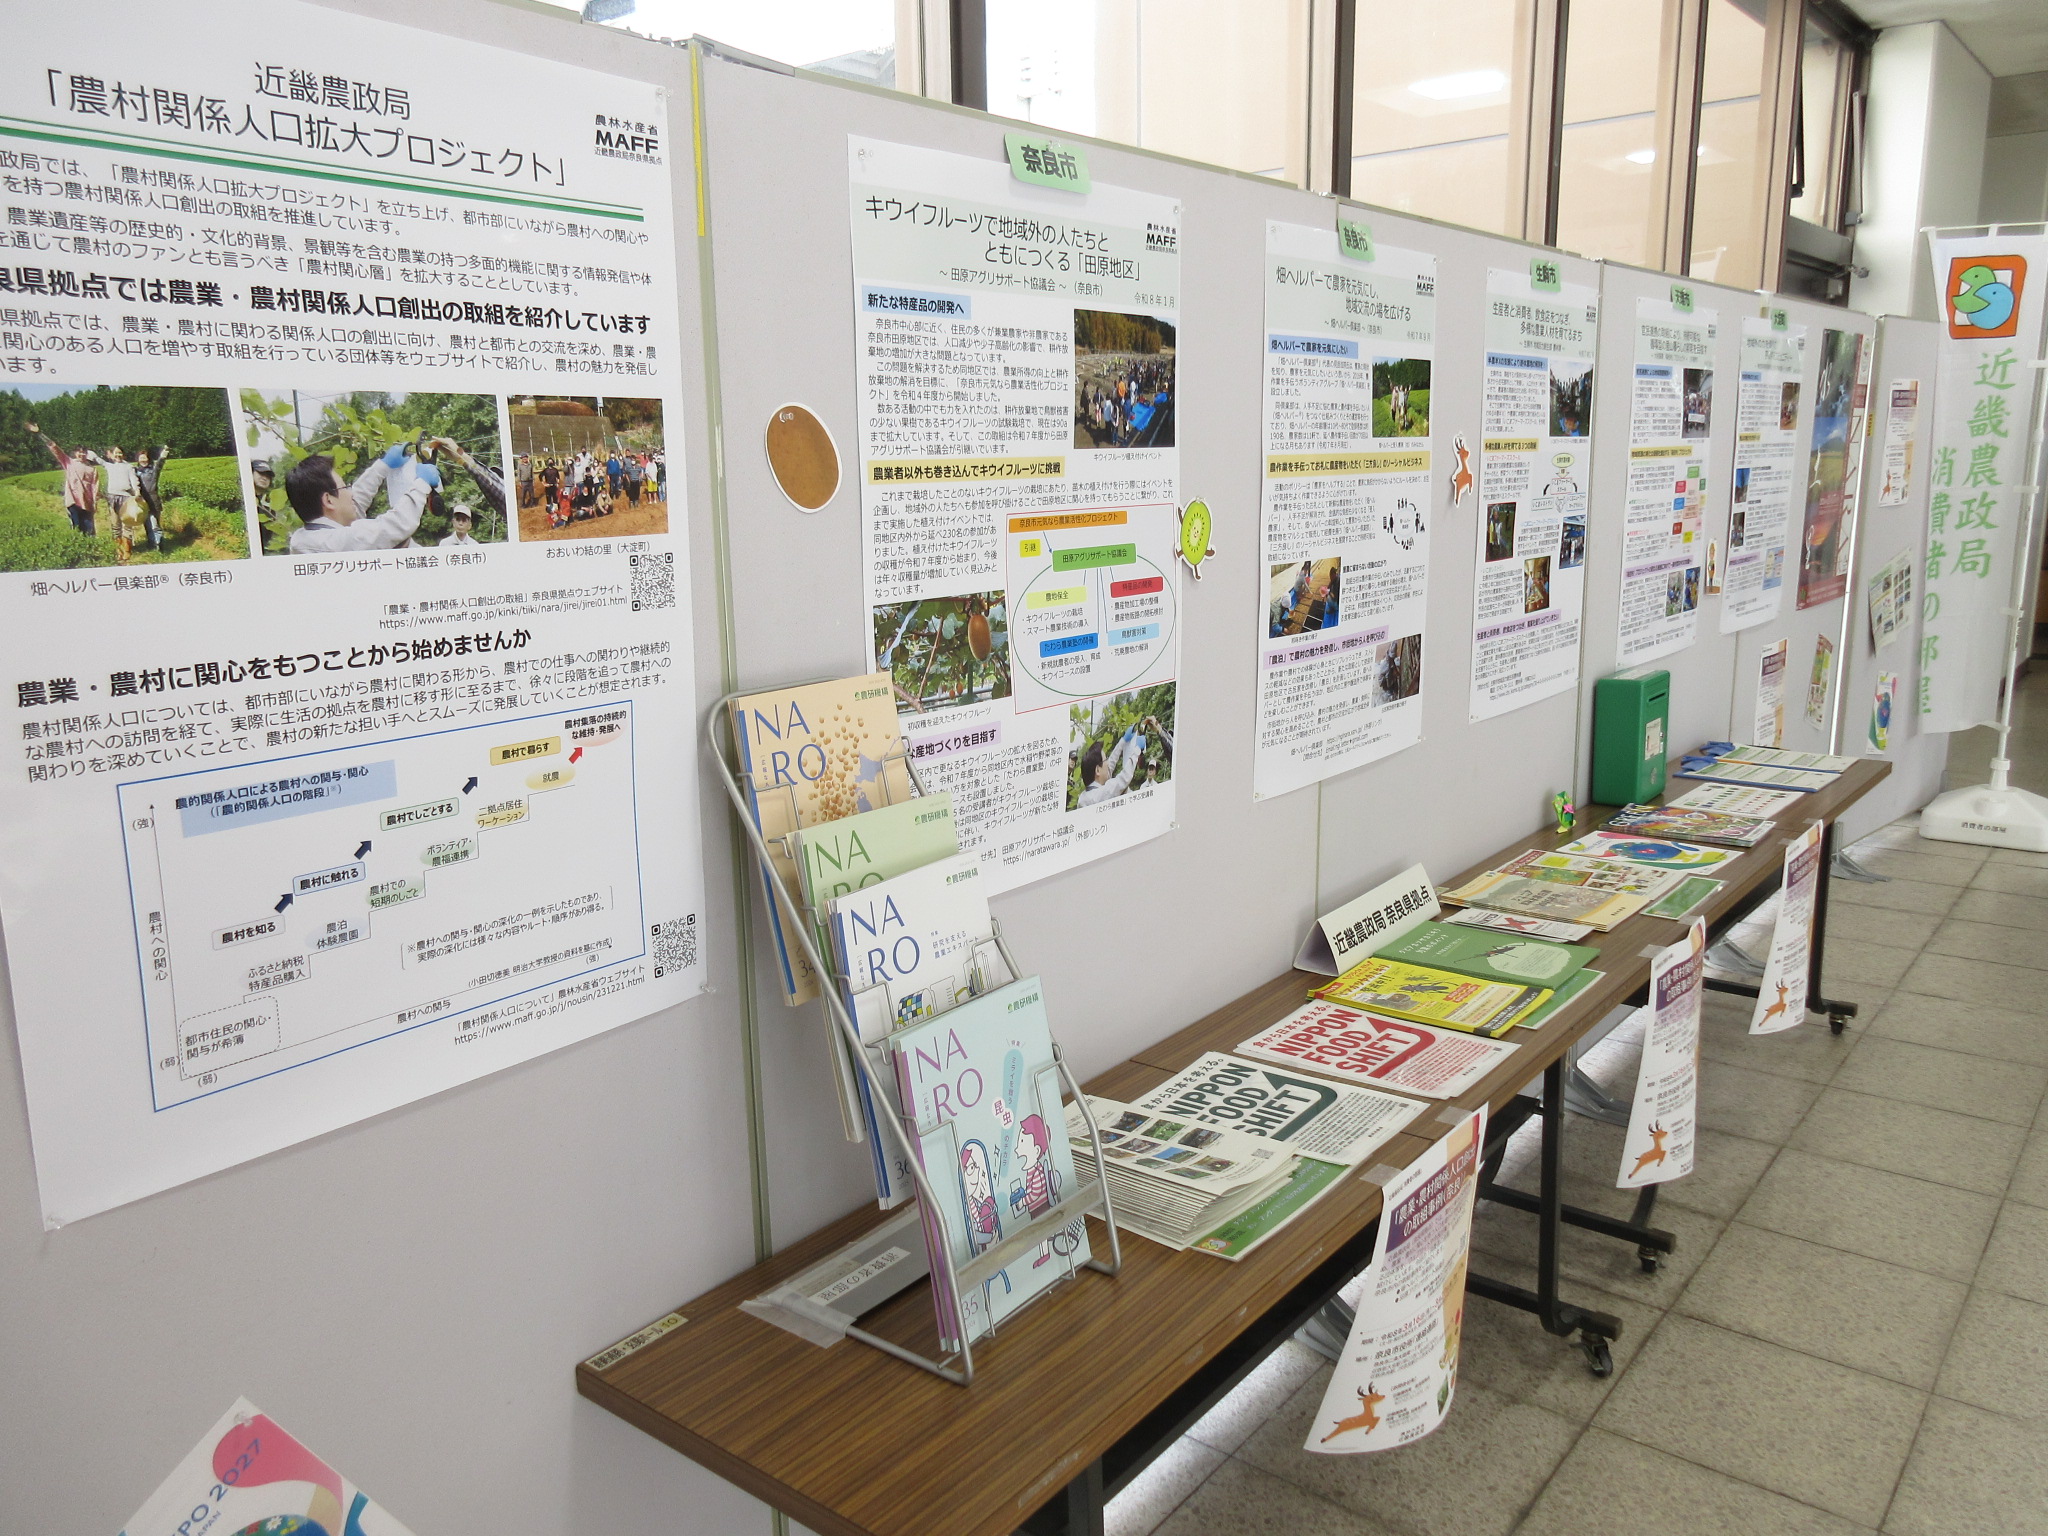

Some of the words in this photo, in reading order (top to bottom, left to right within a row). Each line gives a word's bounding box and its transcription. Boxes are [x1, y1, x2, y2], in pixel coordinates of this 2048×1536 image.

[254, 61, 411, 120] 近畿農政局
[46, 68, 567, 187] 「農村関係人口拡大プロジェクト」
[595, 114, 659, 136] 農林水産省
[595, 129, 660, 154] MAFF
[594, 147, 663, 166] 近畿農政局奈良県拠点
[1020, 144, 1078, 181] 奈良市
[0, 150, 650, 245] 政局では、「農村関係人口拡大プロジェクト」を立ち上げ、都市部にいながら農村への関心や
[3, 174, 402, 237] を持つ農村関係人口創出の取組を推進しています。
[866, 195, 1109, 254] キウイフルーツで地域外の人たちと
[8, 206, 652, 286] 農業遺産等の歴史的・文化的背景、景観等を含む農業の持つ多面的機能に関する情報発信や体
[1146, 233, 1177, 248] MAFF
[985, 241, 1141, 282] ともにつくる「田原地区」
[951, 269, 1056, 293] 田原アグリサポート協議会
[1074, 280, 1103, 297] （奈良市）
[1416, 282, 1434, 293] MAFF
[867, 293, 965, 315] 新たな特産品の開発へ
[1134, 292, 1175, 308] 令和8年1月
[1345, 298, 1411, 322] 地域交流の場を広げる
[0, 331, 659, 377] 関心のある人口を増やす取組を行っている団体等をウェブサイトで紹介し、農村の魅力を発信し
[1271, 339, 1349, 355] 畑ヘルパーで農家を元気にしたい
[873, 461, 1061, 481] 農業者以外も巻き込んでキウイフルーツに挑戦
[1951, 348, 2018, 578] 近畿農政局
[293, 552, 488, 577] 田原アグリサポート協議会（奈良市）
[546, 541, 650, 560] おおいわ結の里（大淀町）
[1062, 549, 1128, 564] 田原アグリサポート協議会
[381, 584, 623, 616] 「農業・農村関係人口創出の取組」奈良県拠点ウェブサイト
[874, 585, 924, 599] なっています。
[379, 596, 628, 630] https://www.maff.go.jp/kinki/tiiki/nara/jirei/jirei01.html
[17, 628, 532, 708] 農業・農村に関心をもつことから始めませんか
[22, 641, 671, 740] 農村関係人口については、都市部にいながら農村に関わる形から、農村での仕事への関わりや継続的
[860, 686, 889, 700] 農研機構
[25, 656, 672, 761] な農村への訪問を経て、実際に生活の拠点を農村に移す形に至るまで、徐々に段階を追って農村への
[564, 710, 627, 730] 農村集落の持続的
[28, 674, 668, 783] 関わりを深めていくことで、農村の新たな担い手へとスムーズに発展していくことが想定されます。
[571, 723, 621, 740] な維持・発展へ
[753, 701, 811, 745] NA
[502, 742, 550, 760] 農村で暮らす
[771, 743, 826, 786] RO
[175, 766, 369, 811] 農的関係人口による農村への関与・関心
[542, 771, 560, 783] 就農
[386, 803, 454, 826] 農村でしごとする
[477, 810, 525, 829] ワーケーション
[478, 799, 523, 816] 二拠点居住
[919, 808, 949, 825] 農研機構
[432, 849, 470, 868] 農福連携
[814, 829, 872, 879] NA
[300, 867, 359, 891] 農村に触れる
[369, 879, 406, 896] 農村での
[951, 867, 979, 885] 農研機構
[370, 888, 419, 909] 短期のしごと
[222, 921, 276, 945] 農村を知る
[326, 920, 348, 934] 農泊
[850, 895, 905, 945] NA
[1333, 910, 1387, 956] 近畿農政局
[1384, 885, 1432, 926] 奈良県拠点
[149, 911, 168, 982] 農村への関心
[316, 928, 359, 950] 体験農園
[932, 930, 967, 949] 研究を支える
[248, 955, 305, 979] ふるさと納税
[867, 935, 920, 984] RO
[249, 969, 306, 992] 特産品購入
[454, 975, 646, 1046] https://www.maff.go.jp/j/nousin/231221.html
[456, 962, 646, 1033] 「農村関係人口について」農林水産省ウェブサイト
[396, 999, 452, 1025] 農村への関与
[1252, 1004, 1331, 1049] 食から日本を考える。
[1269, 1008, 1363, 1057] NIPPON
[186, 1034, 245, 1061] 関与が希薄
[915, 1028, 968, 1084] NA
[1302, 1030, 1372, 1066] FOOD
[1335, 1033, 1410, 1074] SHIFT
[932, 1068, 984, 1124] RO
[1141, 1058, 1224, 1110] 食から日本を考える。
[1159, 1062, 1258, 1118] NIPPON
[994, 1099, 1013, 1127] 昆虫
[1196, 1087, 1269, 1124] FOOD
[1232, 1089, 1310, 1137] SHIFT
[209, 1438, 263, 1502] 2027
